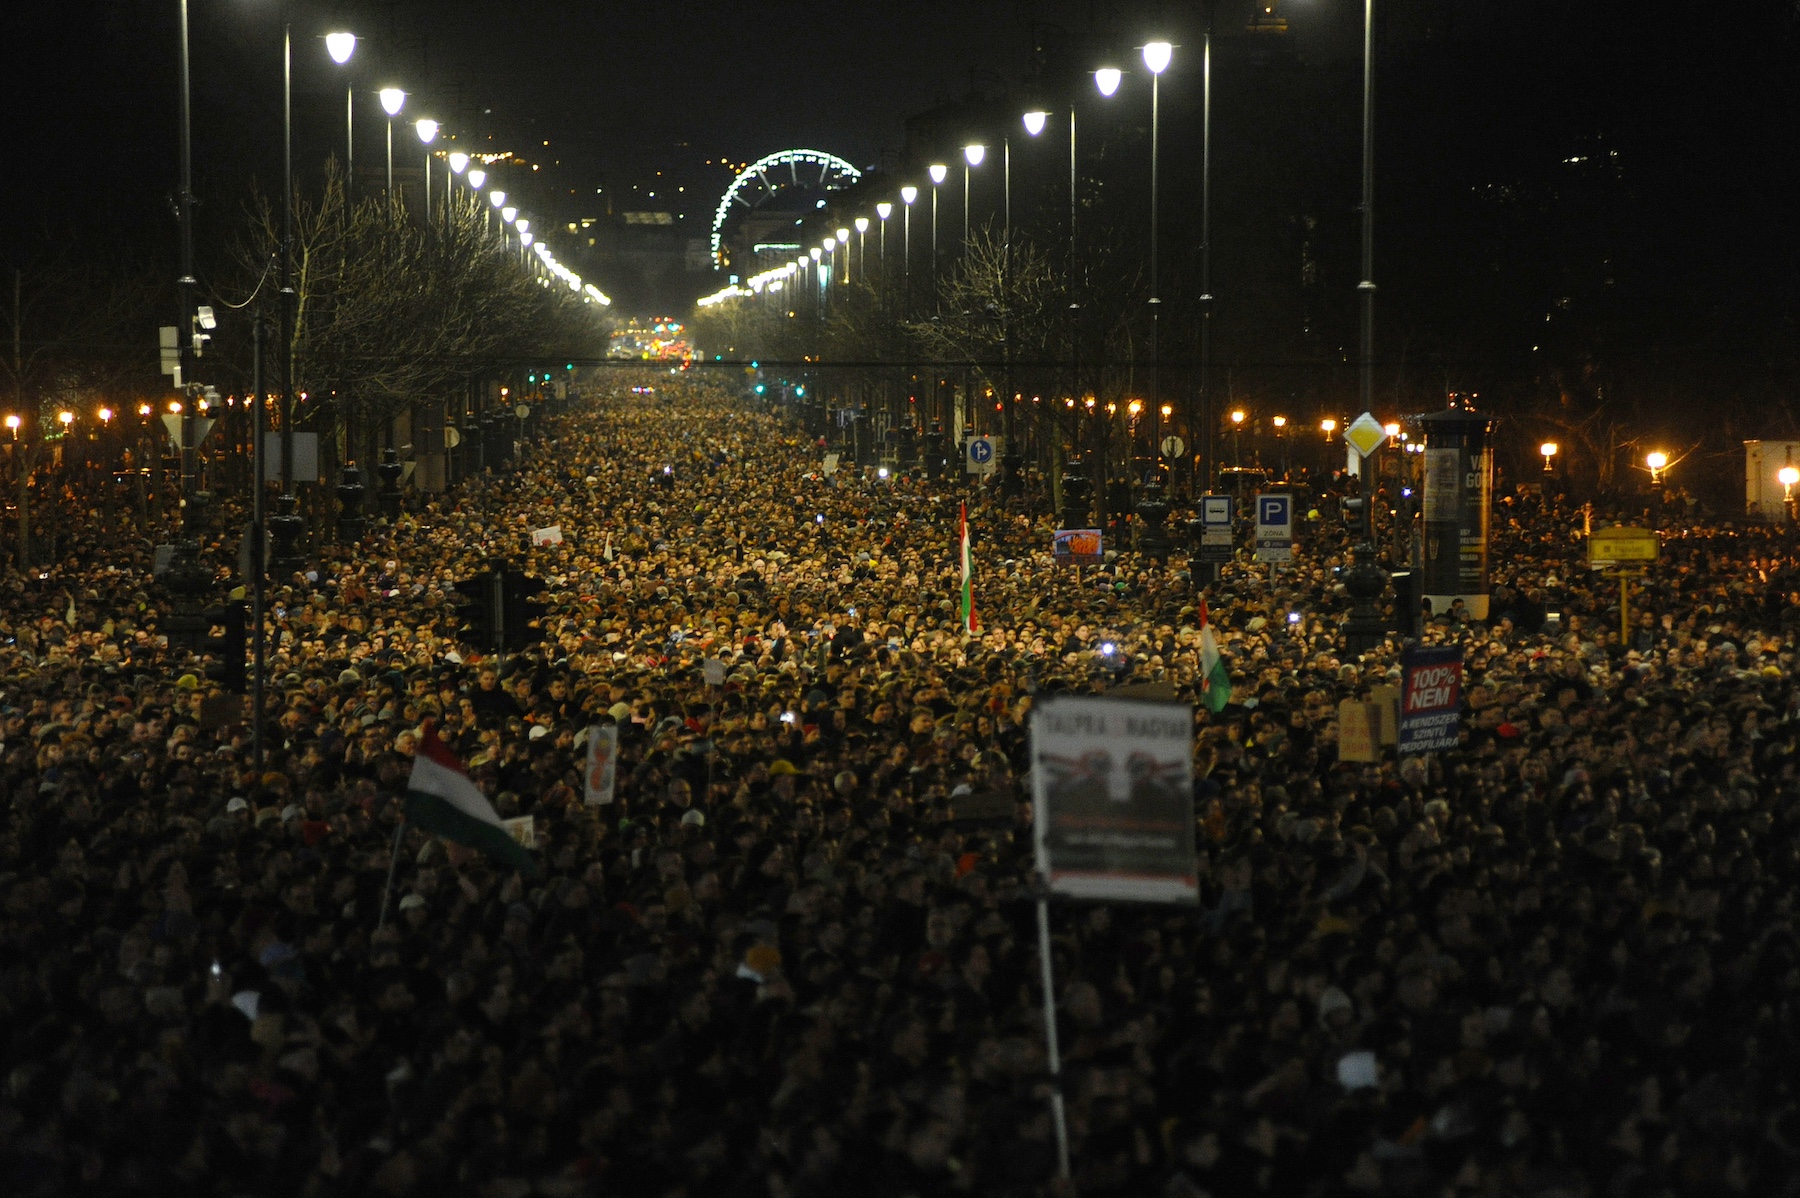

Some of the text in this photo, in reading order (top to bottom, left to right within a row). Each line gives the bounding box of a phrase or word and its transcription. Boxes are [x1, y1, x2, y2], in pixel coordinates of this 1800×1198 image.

[1266, 502, 1282, 521] P
[1413, 667, 1456, 689] 100%
[1409, 686, 1451, 711] NEM
